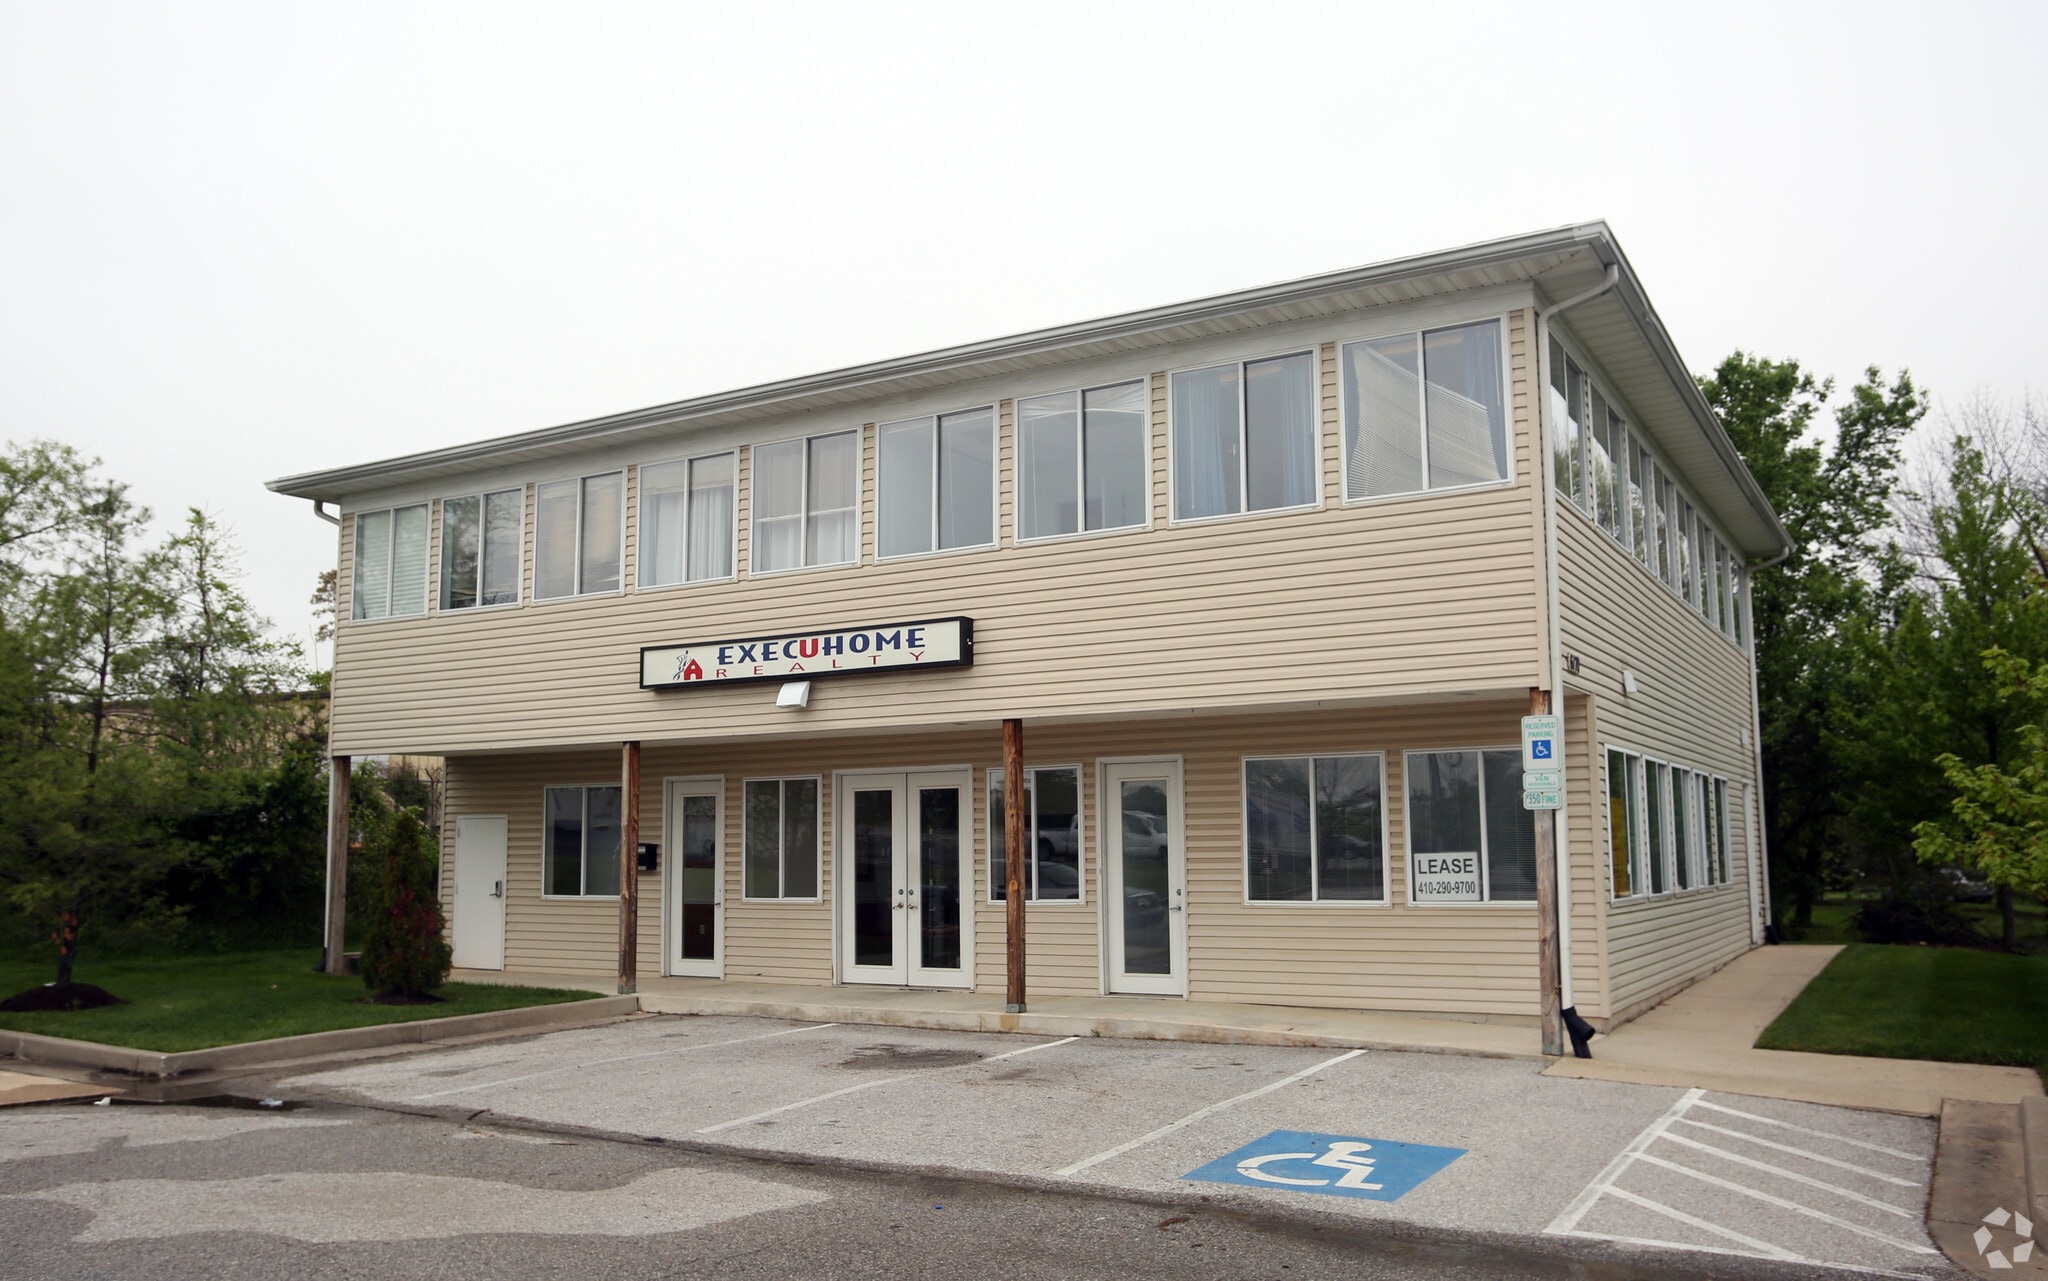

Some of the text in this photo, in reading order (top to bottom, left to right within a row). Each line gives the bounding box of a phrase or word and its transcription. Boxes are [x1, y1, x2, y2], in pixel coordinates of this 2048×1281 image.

[717, 628, 926, 665] EXECUHOME
[716, 651, 925, 678] REALTY
[1542, 795, 1557, 803] FINE
[1418, 858, 1474, 874] LEASE
[1418, 881, 1476, 894] 410-290-9700
